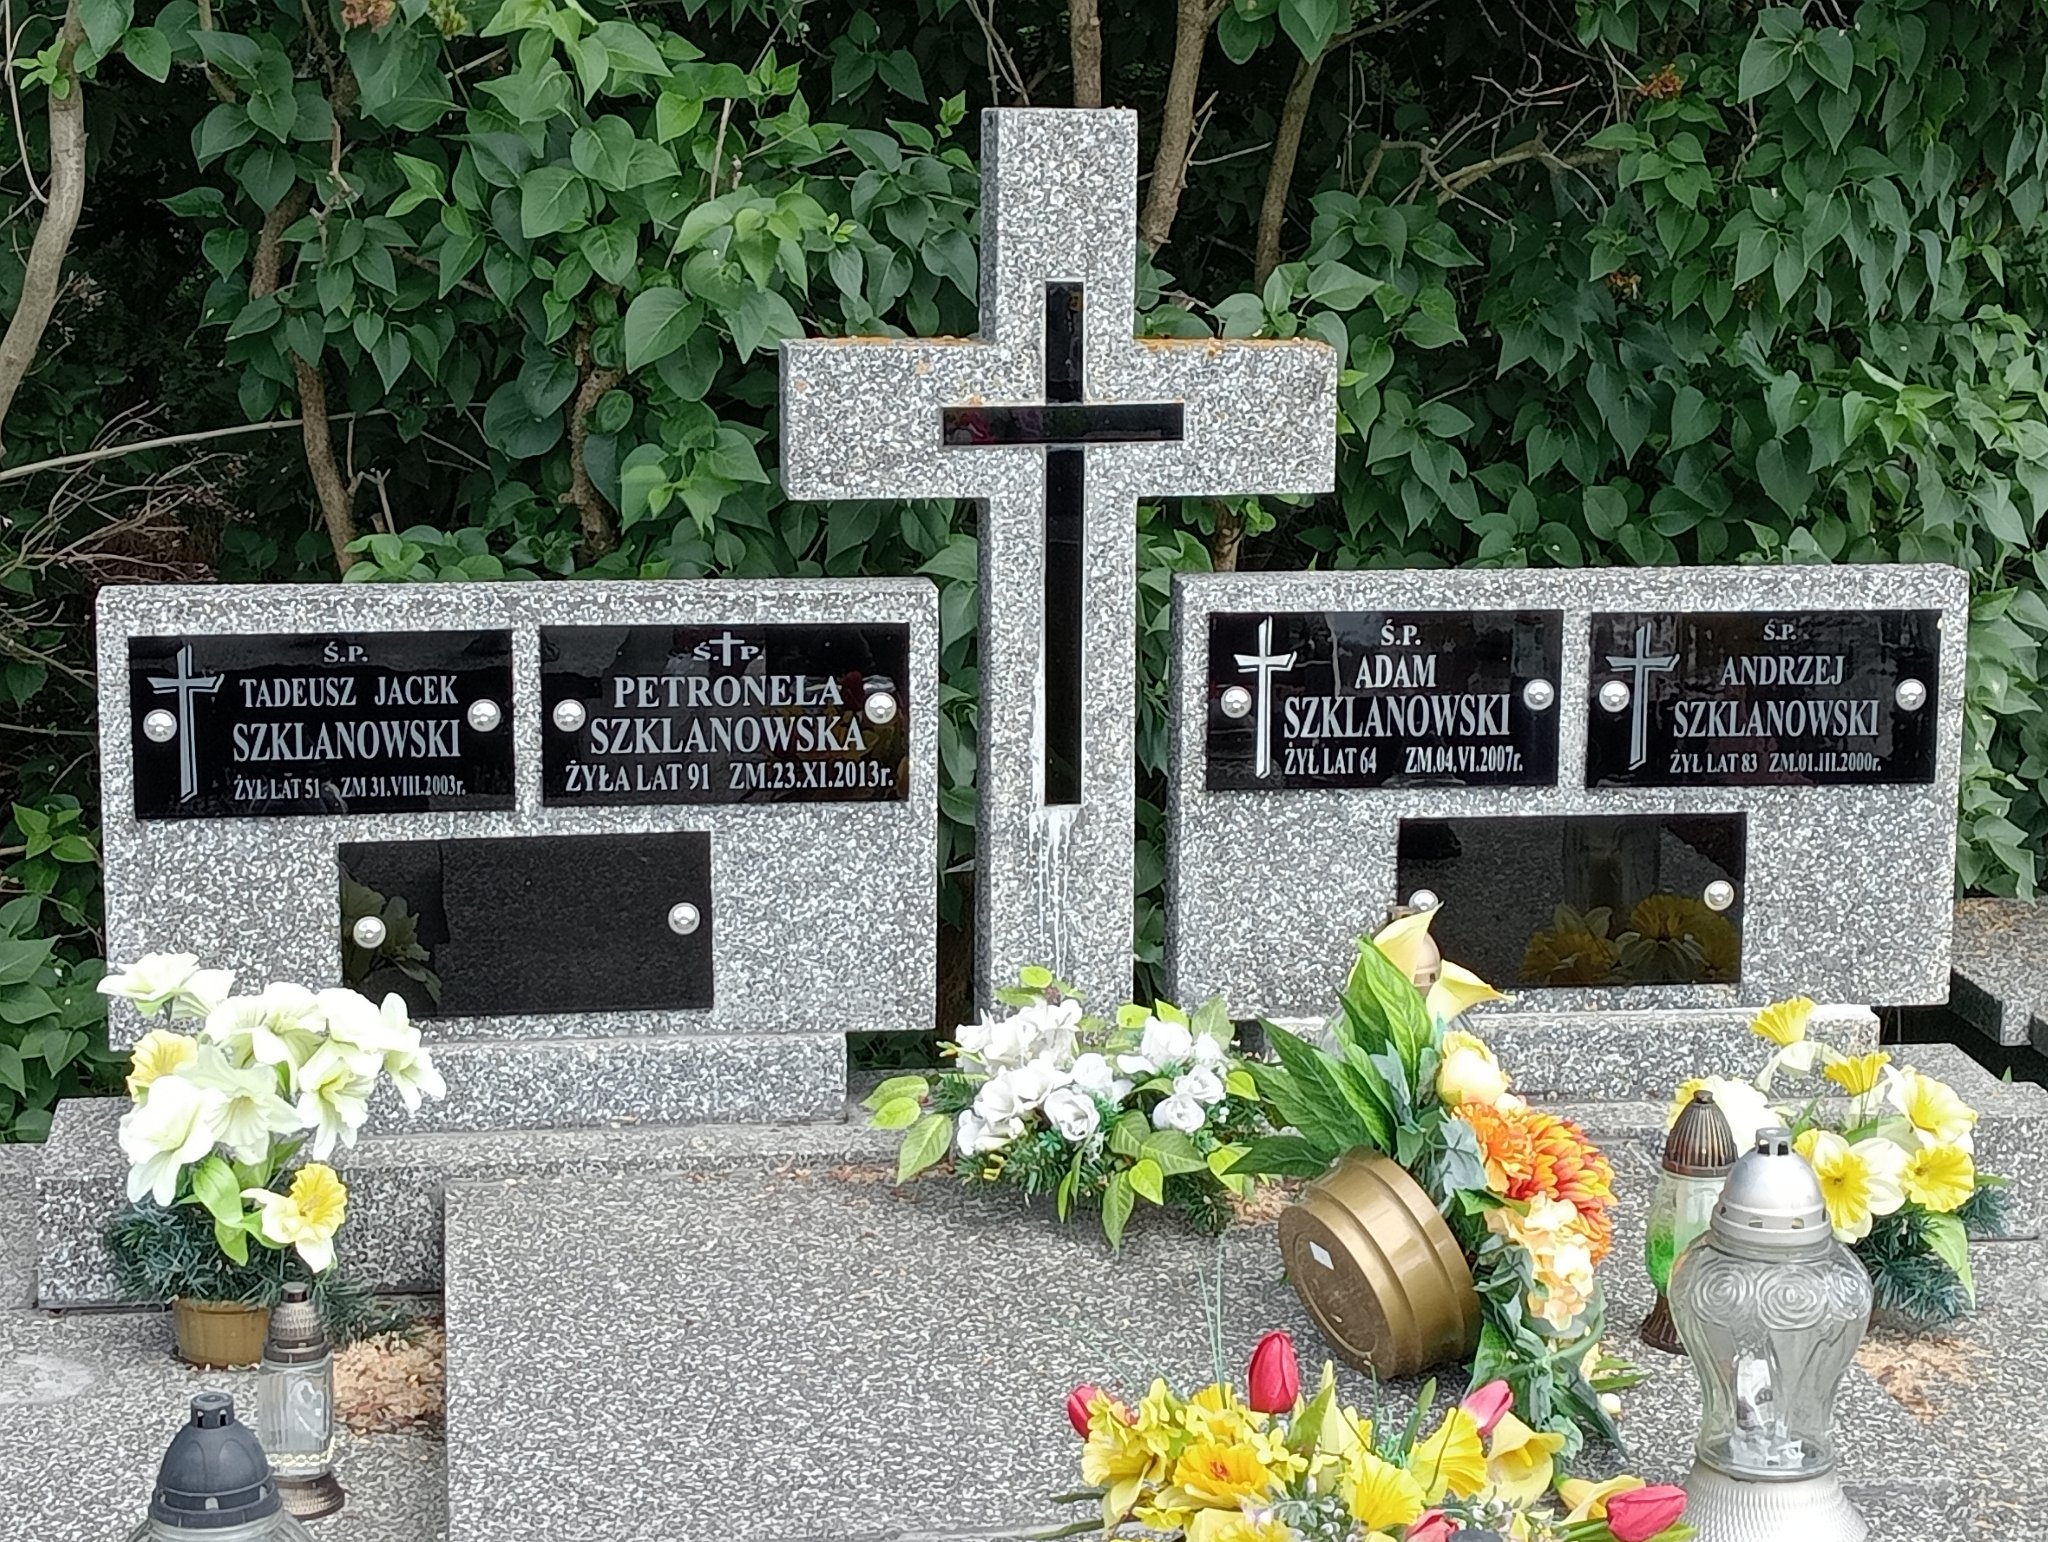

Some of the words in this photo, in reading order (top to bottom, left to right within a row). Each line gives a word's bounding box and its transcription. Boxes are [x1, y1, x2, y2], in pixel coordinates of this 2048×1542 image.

[1380, 619, 1421, 647] Ś.P.
[1354, 654, 1437, 690] ADAM
[1720, 655, 1845, 687] ANDRZEJ
[240, 677, 357, 708] TADEUSZ
[374, 675, 459, 706] JACEK
[613, 675, 844, 708] PETRONELA
[1283, 693, 1511, 739] SZKLANOWSKI
[1673, 699, 1879, 738] SZKLANOWSKI
[232, 719, 461, 762] SZKLANOWSKI
[590, 717, 867, 755] SZKLANOWSKA
[565, 760, 633, 792] ŻYŁA
[637, 763, 683, 792] LAT
[687, 763, 710, 791] 91
[1323, 747, 1357, 775] LAT
[1360, 747, 1377, 774] 64
[1707, 753, 1739, 774] LAT
[1741, 753, 1758, 773] 83
[270, 778, 301, 800] LAT
[305, 778, 321, 799] 51
